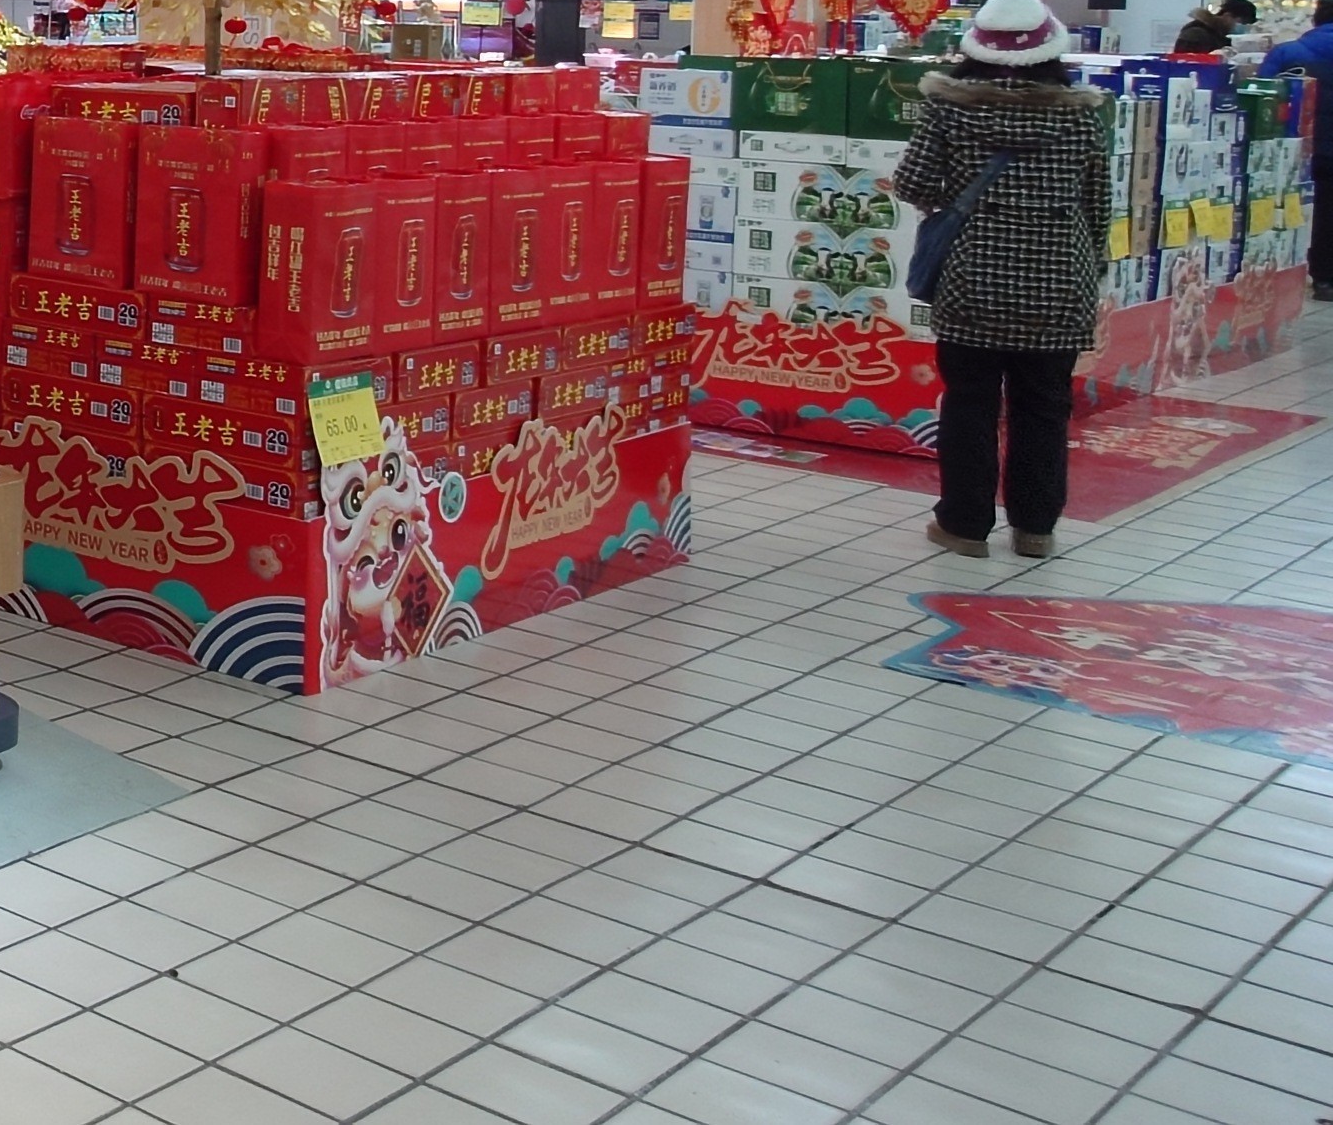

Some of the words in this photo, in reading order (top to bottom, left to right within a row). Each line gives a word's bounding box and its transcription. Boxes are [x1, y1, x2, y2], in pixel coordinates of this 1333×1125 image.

[161, 105, 181, 120] 20
[68, 188, 83, 242] 王老吉
[177, 201, 192, 257] 王老吉
[34, 290, 93, 322] 王老吉
[118, 303, 138, 318] 20
[195, 304, 236, 324] 王老吉
[44, 329, 81, 349] 王老吉
[576, 329, 610, 359] 王老吉
[645, 316, 677, 345] 王老吉
[140, 345, 180, 365] 王老吉
[506, 345, 541, 374] 王老吉
[245, 362, 287, 382] 王老吉
[419, 360, 457, 390] 王老吉
[711, 363, 757, 381] HAPPY
[760, 368, 794, 386] NEW
[796, 372, 832, 390] YEAR
[26, 384, 86, 416] 王老吉
[111, 400, 131, 415] 20
[552, 378, 584, 410] 王老吉
[397, 412, 421, 439] 老吉
[470, 396, 507, 426] 王老吉
[171, 412, 237, 446] 王老吉
[266, 429, 288, 446] 20
[325, 415, 359, 438] 65.00
[269, 483, 290, 499] 20
[510, 522, 540, 542] HAPPY
[541, 517, 564, 536] NEW
[563, 510, 585, 530] YEAR
[23, 519, 61, 542] APPY
[68, 529, 103, 553] NEW
[110, 539, 149, 564] YEAR
